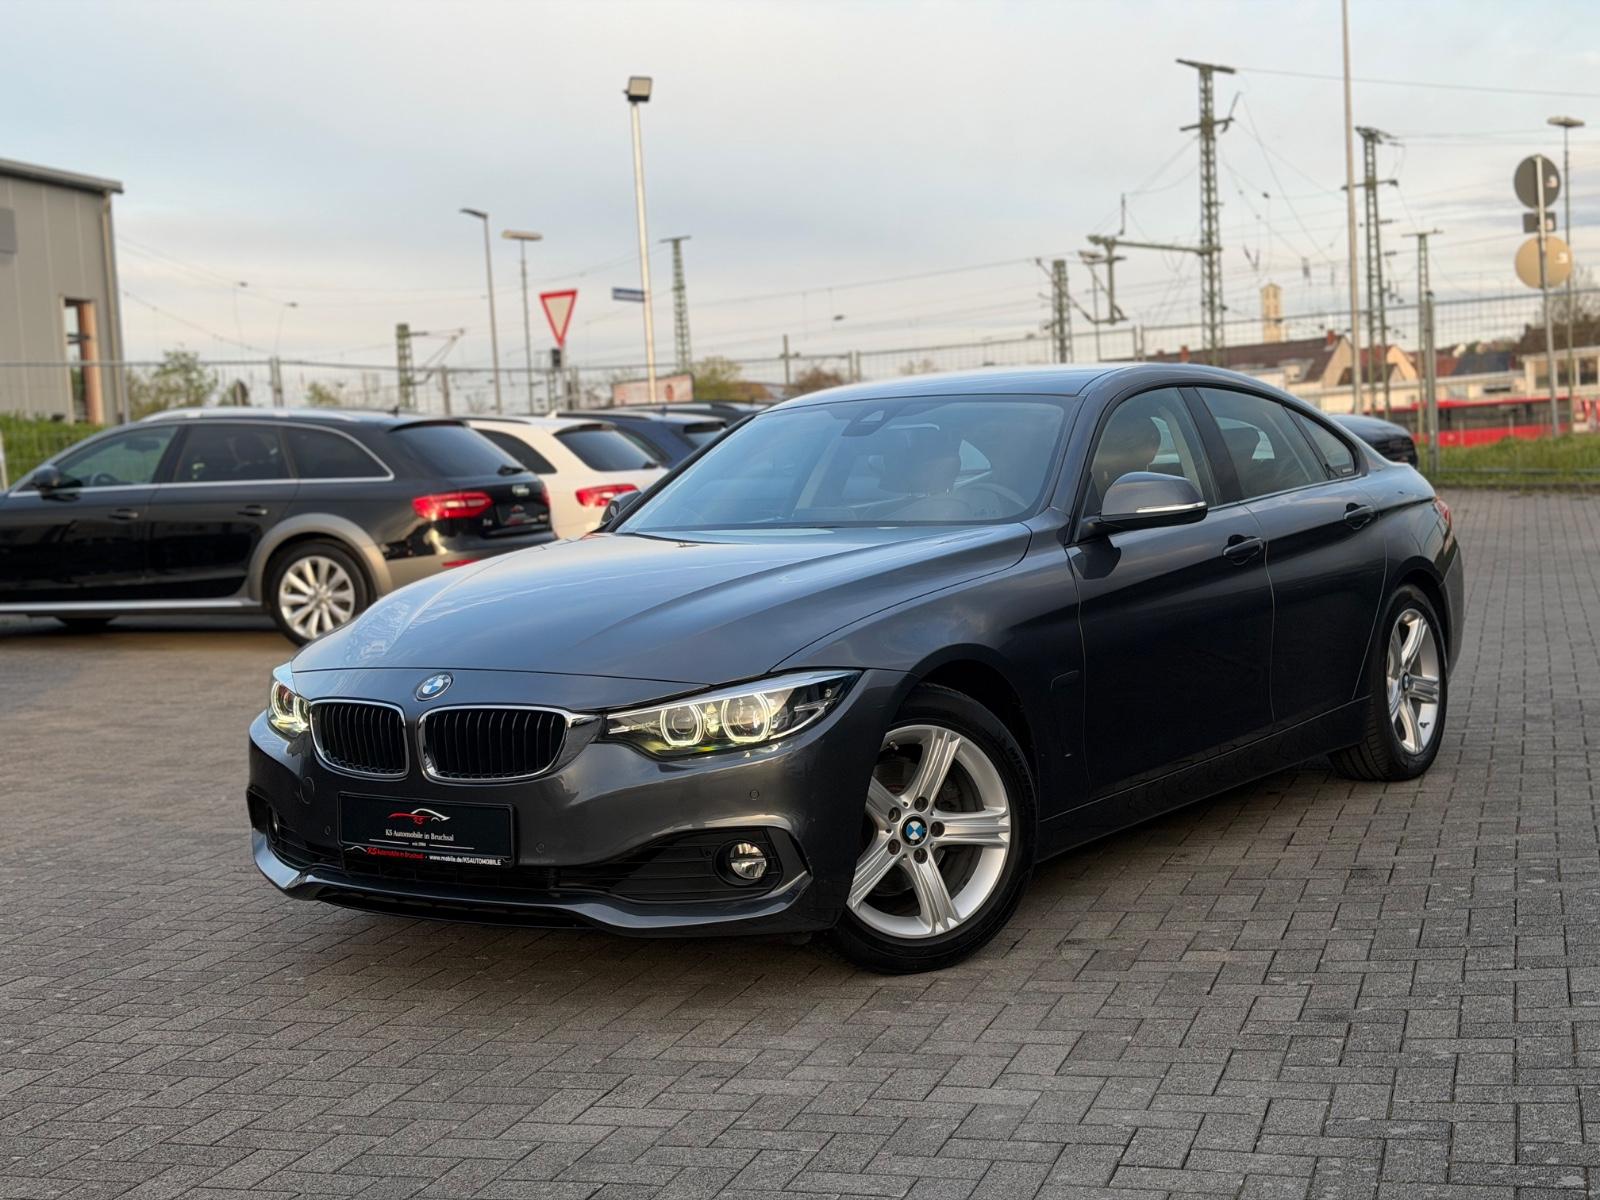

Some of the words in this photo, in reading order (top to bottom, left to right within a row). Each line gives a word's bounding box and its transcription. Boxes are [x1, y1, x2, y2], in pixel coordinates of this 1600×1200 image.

[393, 830, 423, 839] Automobile
[424, 832, 430, 840] in
[430, 832, 455, 841] Bruchsal
[367, 847, 378, 855] KS
[428, 855, 502, 866] www.mobile.de/KSAUTOMOBILE
